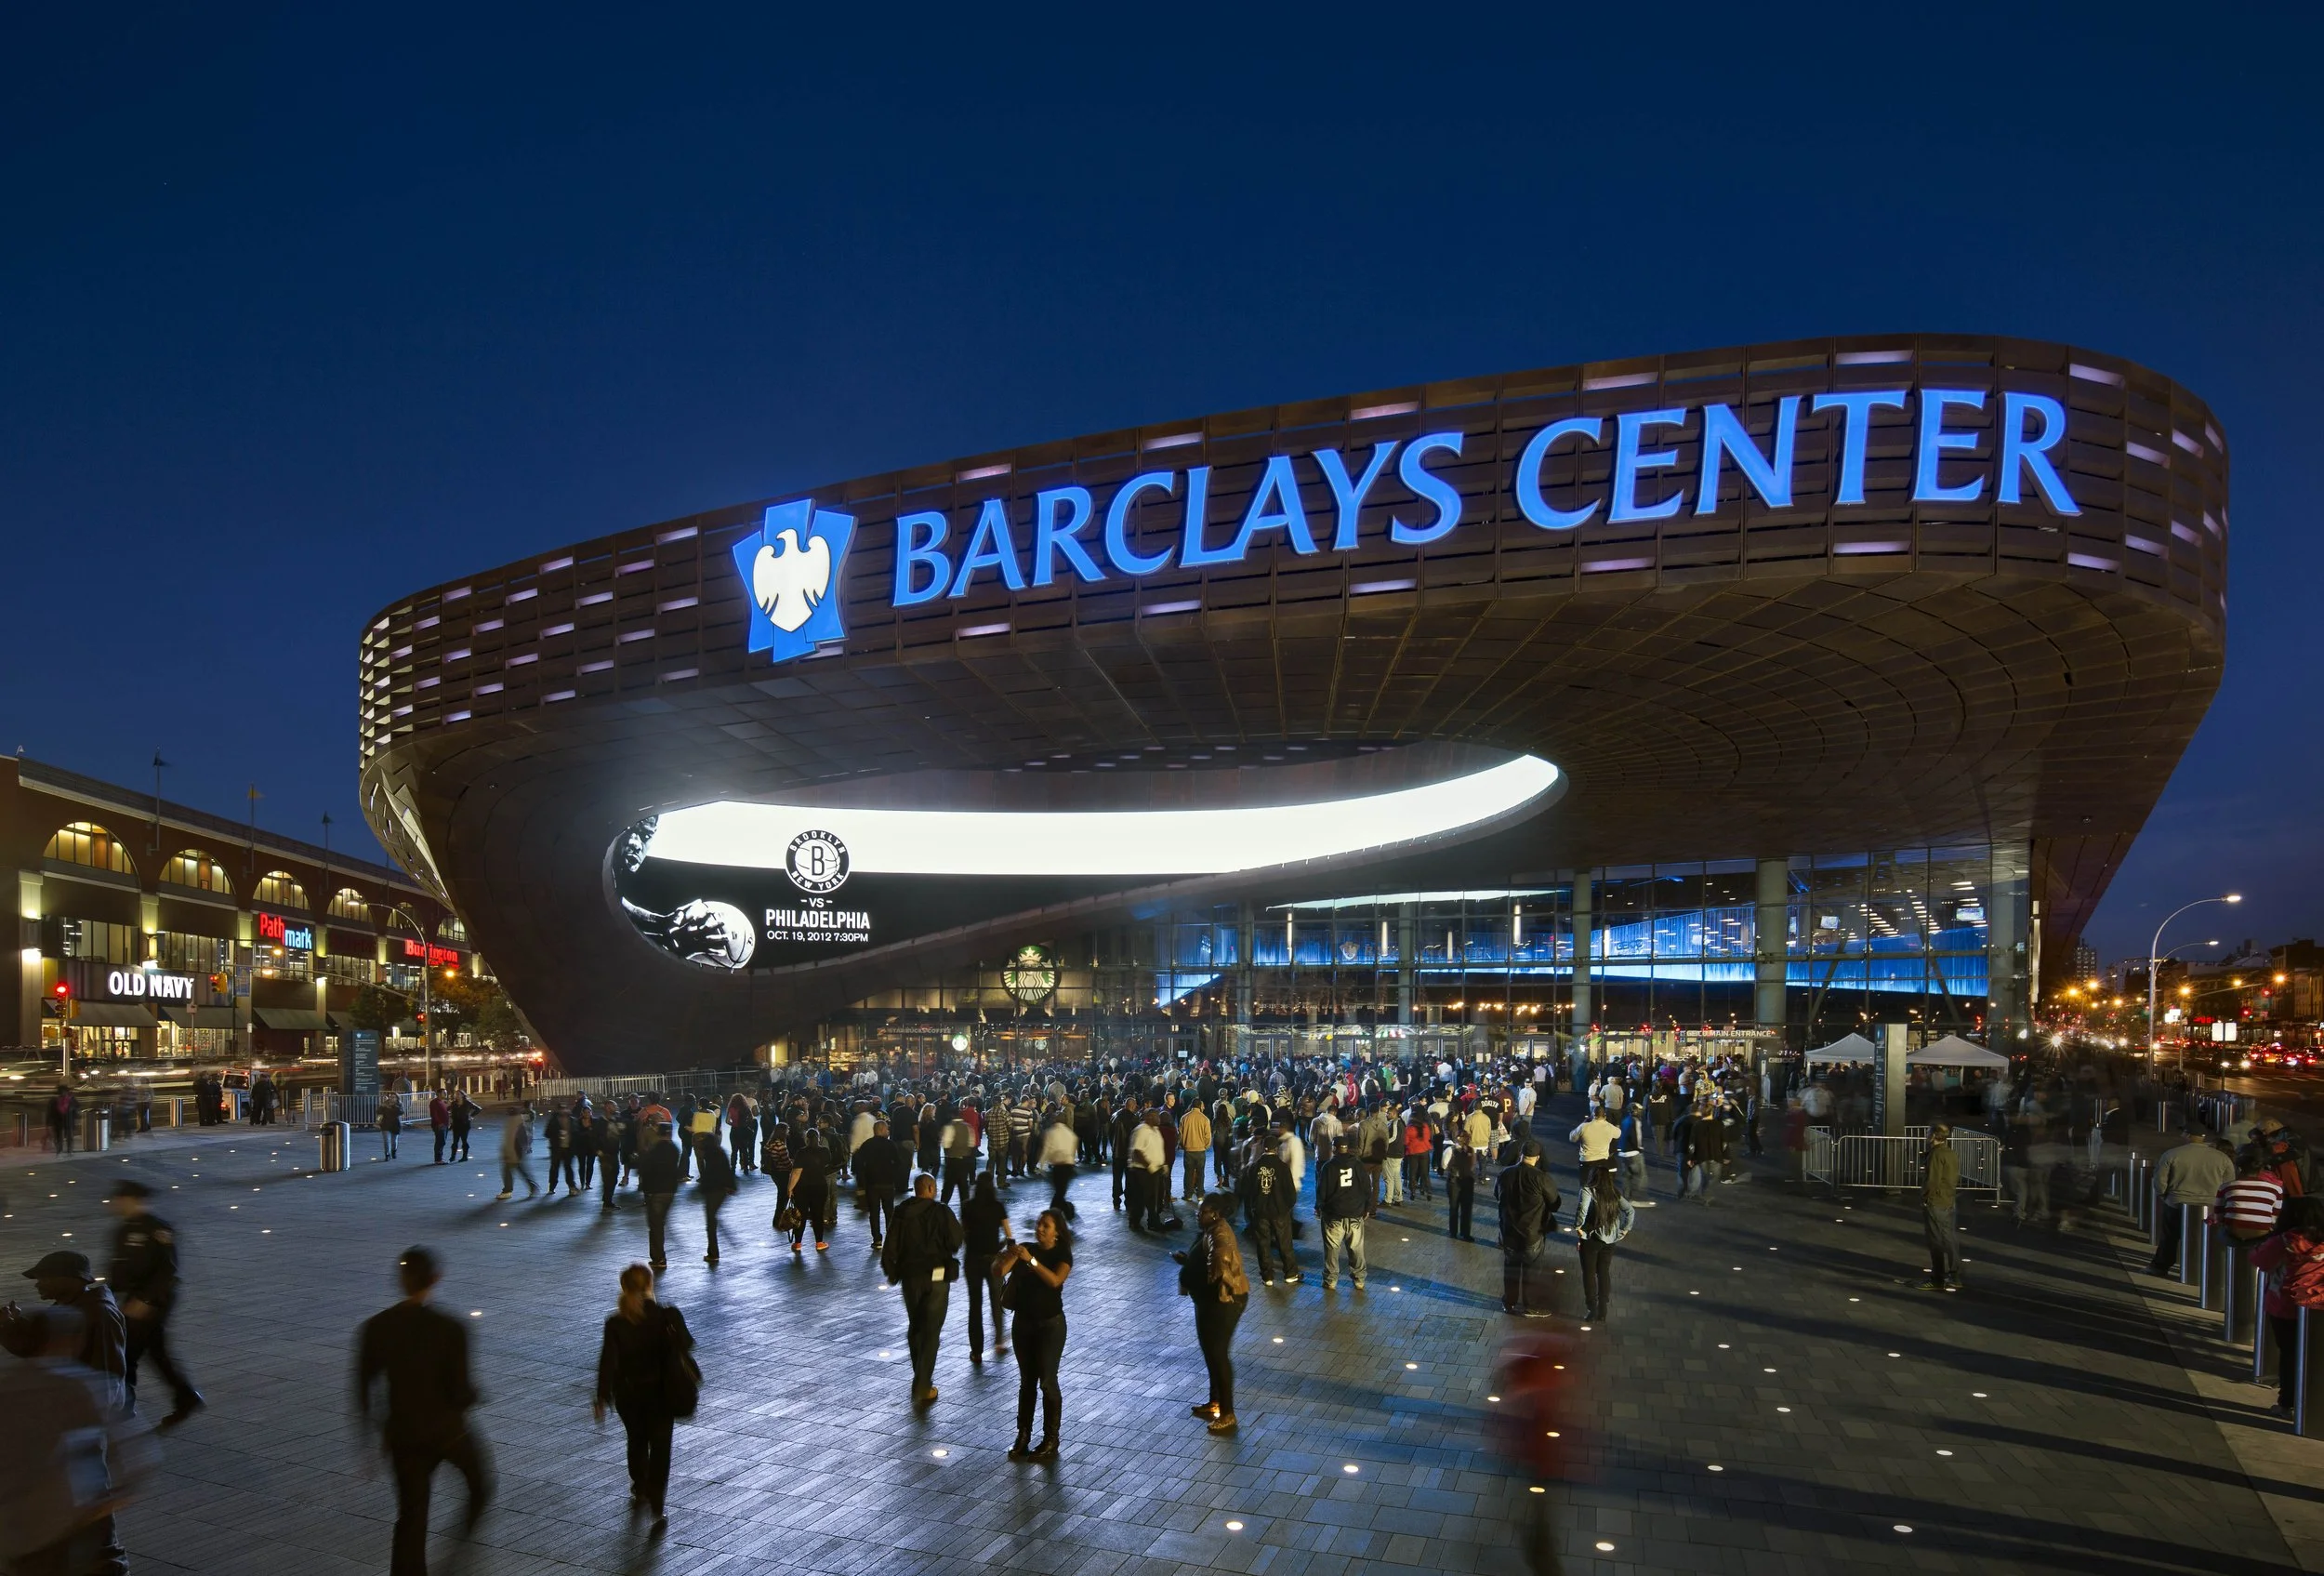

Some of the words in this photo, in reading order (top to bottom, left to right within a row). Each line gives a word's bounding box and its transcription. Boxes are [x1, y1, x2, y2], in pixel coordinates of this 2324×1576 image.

[892, 432, 1463, 607] BARCLAYS
[1515, 389, 2082, 531] CENTER
[789, 830, 846, 854] BROOKLYN
[812, 845, 825, 876] B
[791, 870, 813, 890] NEW
[818, 872, 845, 891] YORK
[765, 908, 871, 929] PHILADELPHIA
[259, 913, 312, 949] Pathmark
[767, 931, 789, 940] OCT.
[792, 932, 805, 942] 19,
[807, 932, 832, 941] 2012
[833, 933, 868, 942] 7:30PM
[404, 938, 458, 963] Burington
[109, 971, 146, 995] OLD
[149, 974, 195, 1000] NAVY
[1730, 1029, 1772, 1038] ENTRANCE
[1503, 1098, 1512, 1113] P
[1340, 1167, 1353, 1187] 2
